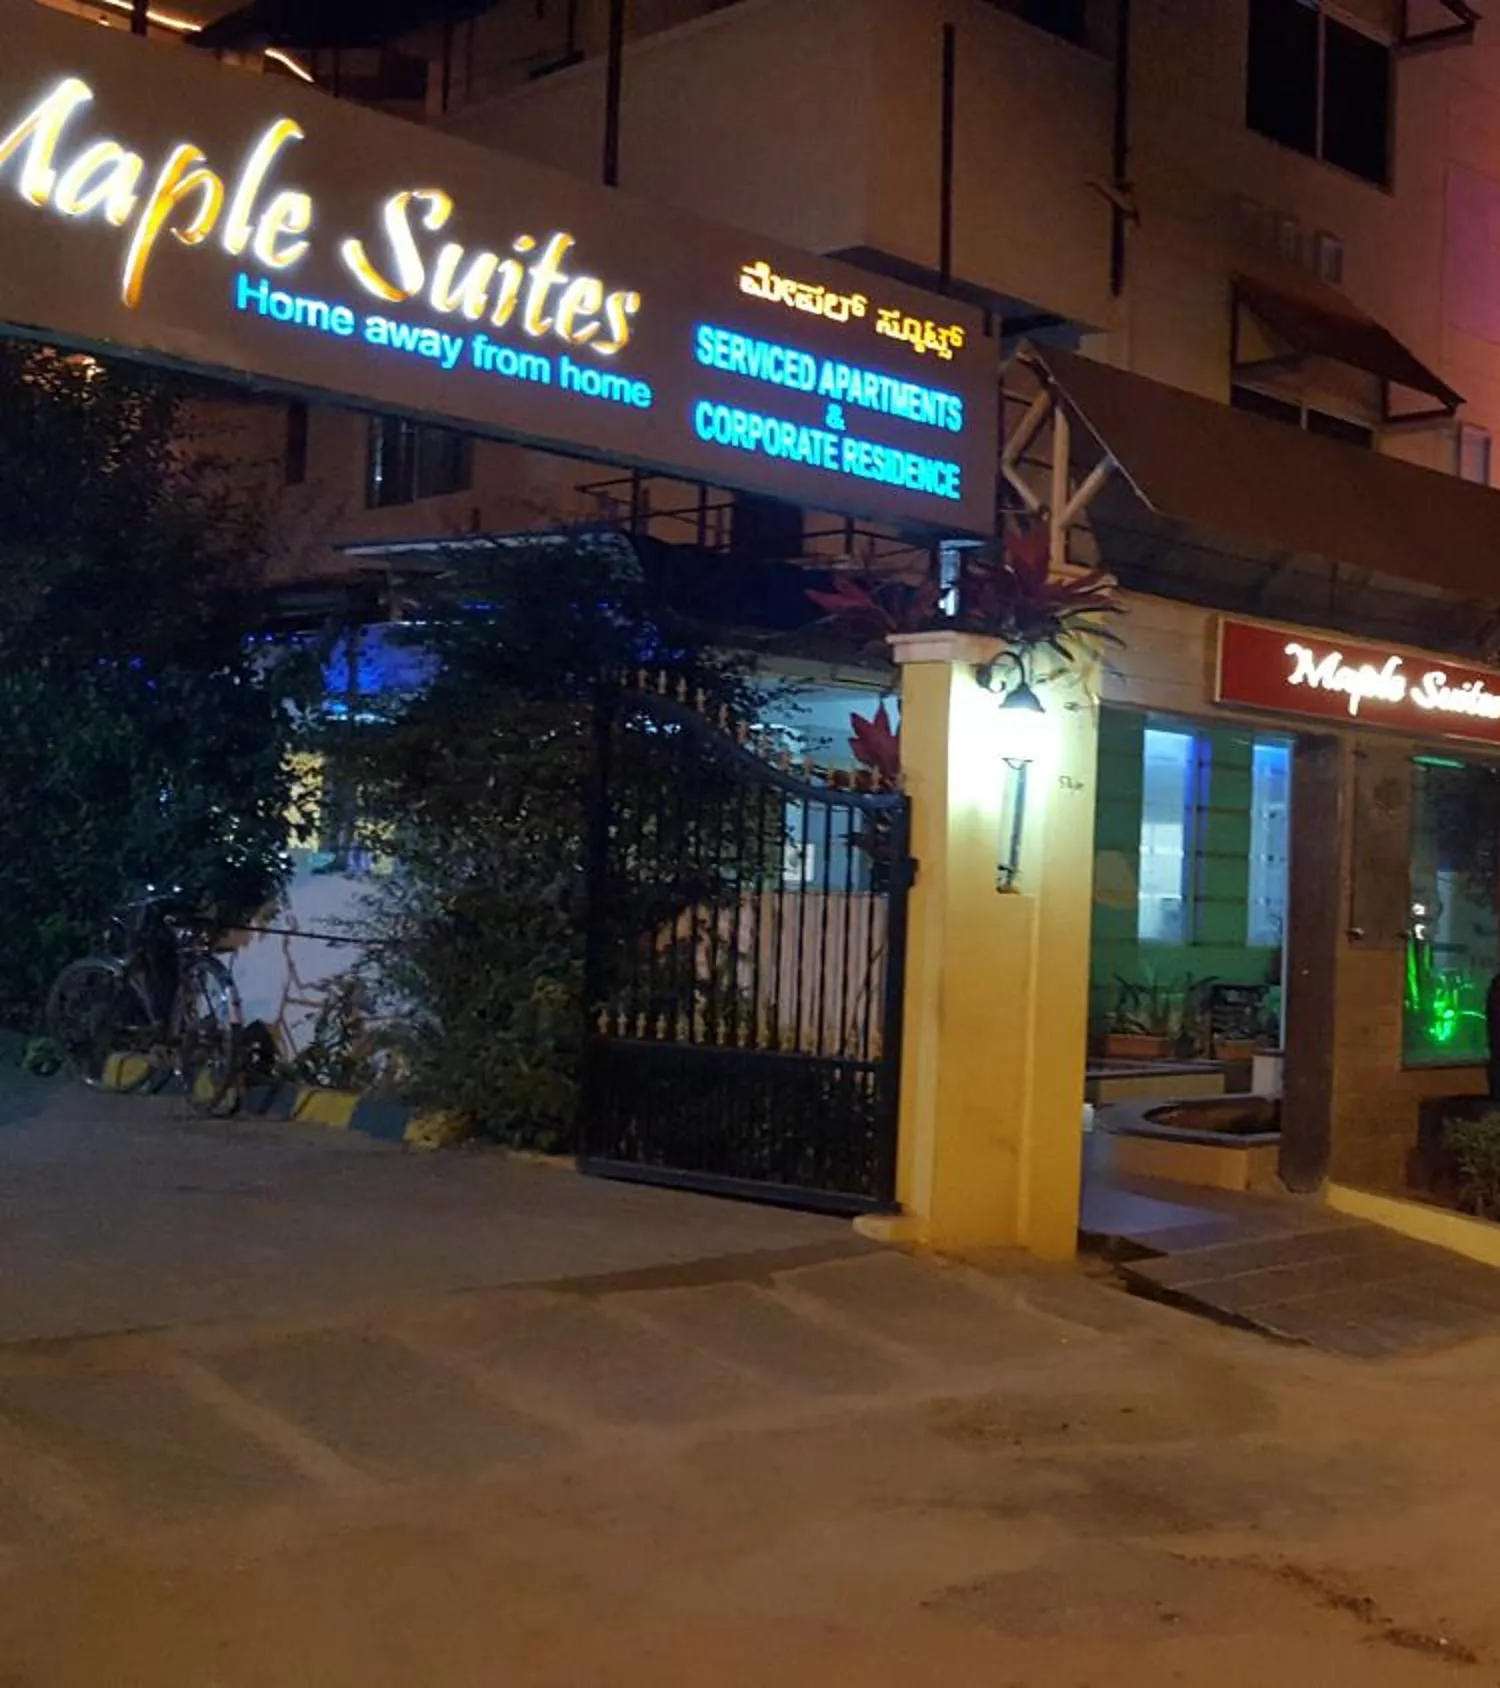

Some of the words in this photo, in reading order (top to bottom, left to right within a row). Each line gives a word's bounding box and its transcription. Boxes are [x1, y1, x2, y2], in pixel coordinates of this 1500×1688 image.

[342, 187, 640, 355] Suites
[236, 272, 355, 336] Home
[365, 315, 464, 368] away
[471, 333, 551, 385] from
[560, 356, 652, 408] home
[697, 325, 816, 391] SERVICED
[818, 360, 964, 432] APARTMENTS
[695, 402, 839, 471] CORPORATE
[842, 438, 961, 499] RESIDENCE
[825, 404, 846, 430] &
[1285, 642, 1406, 716] Maple
